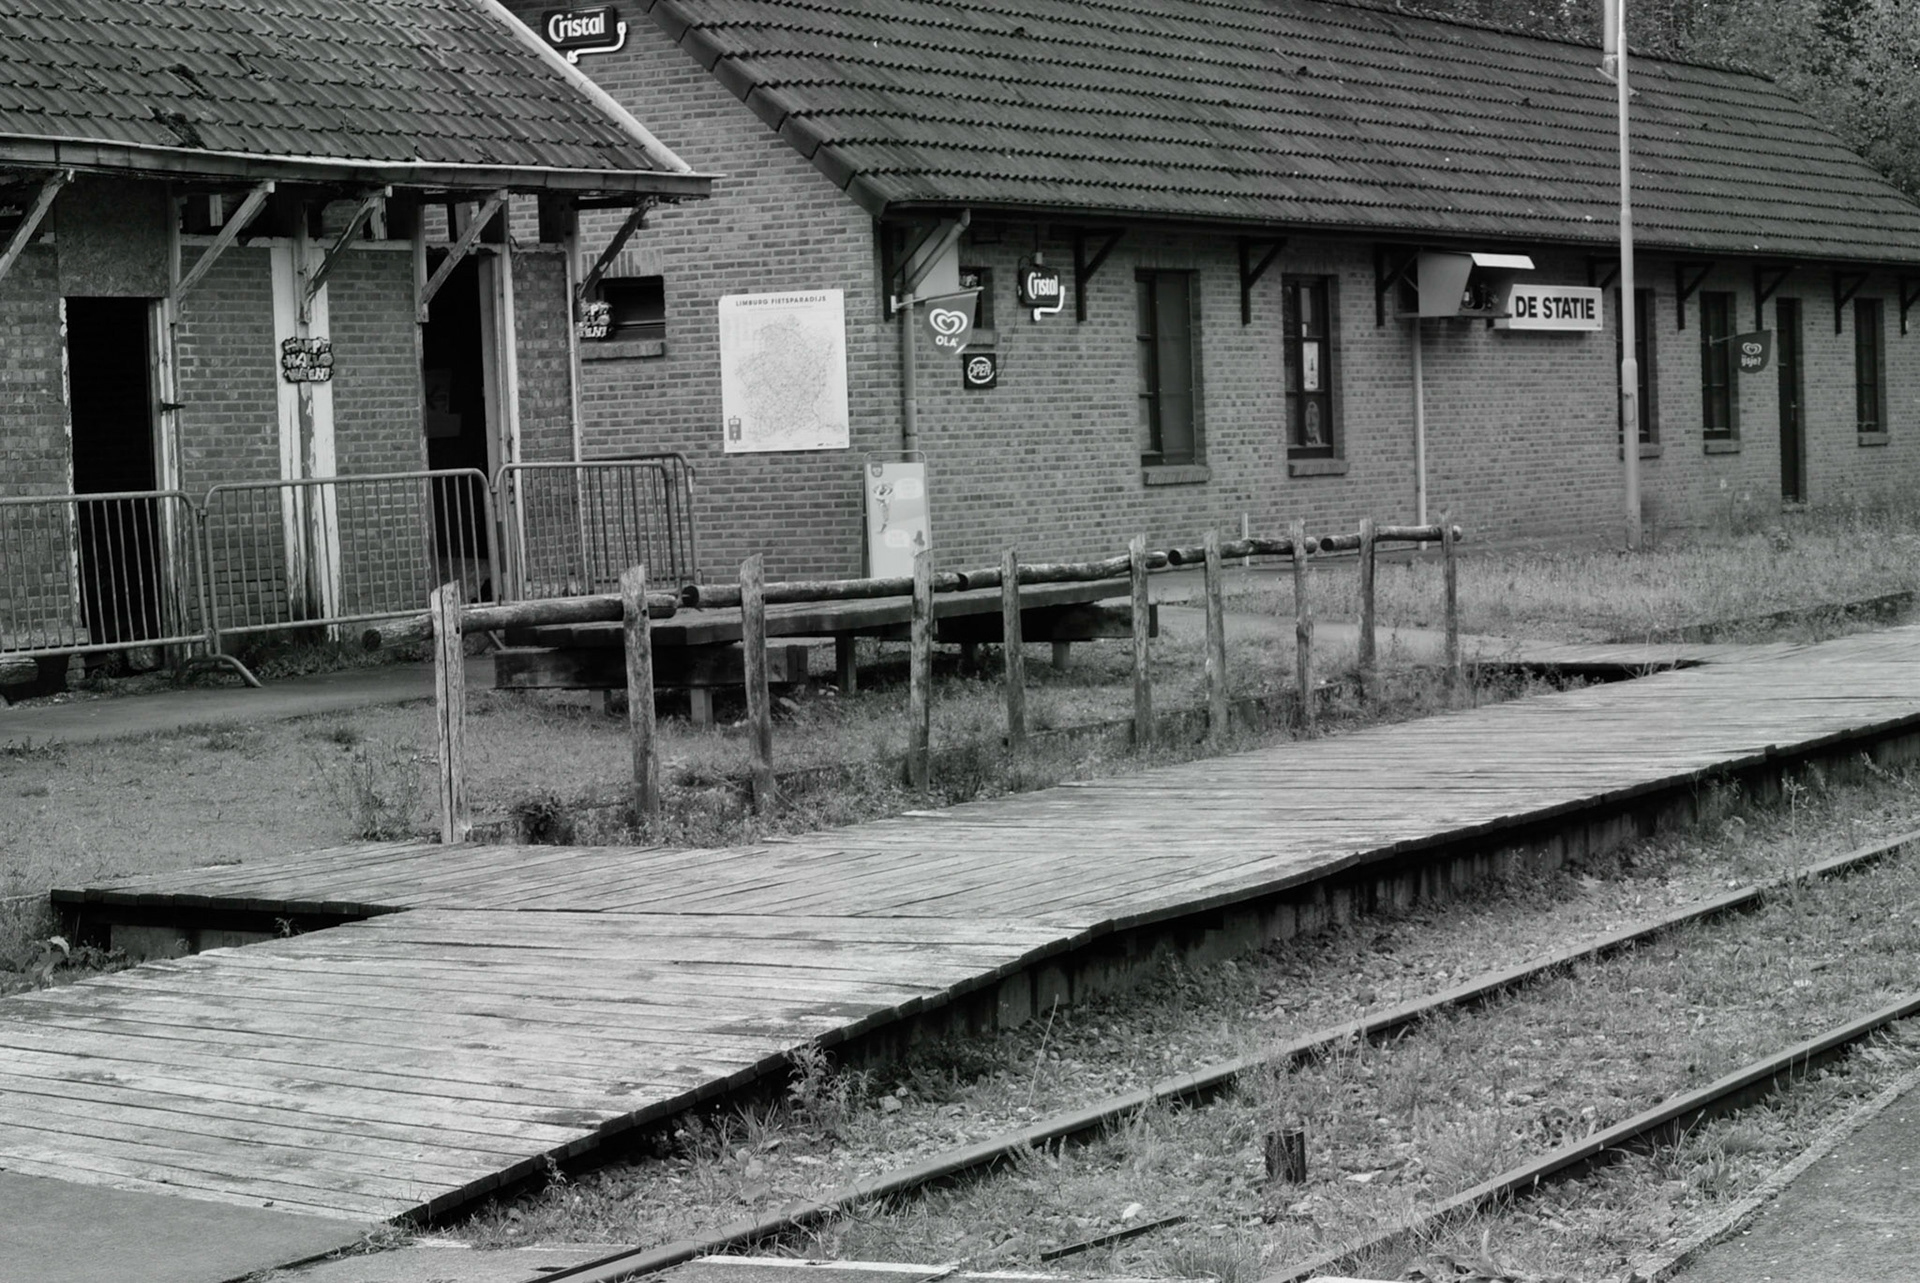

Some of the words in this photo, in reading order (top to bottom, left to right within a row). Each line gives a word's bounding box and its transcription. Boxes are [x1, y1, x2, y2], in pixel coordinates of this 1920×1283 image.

[548, 12, 605, 43] Cristal
[1027, 271, 1058, 300] Cristal
[735, 298, 768, 307] LIMBURG
[771, 295, 826, 305] FIETSPARADIJS
[1515, 296, 1537, 318] DE
[1543, 296, 1595, 319] STATIE
[935, 335, 957, 347] OLA
[968, 363, 991, 377] OPEN
